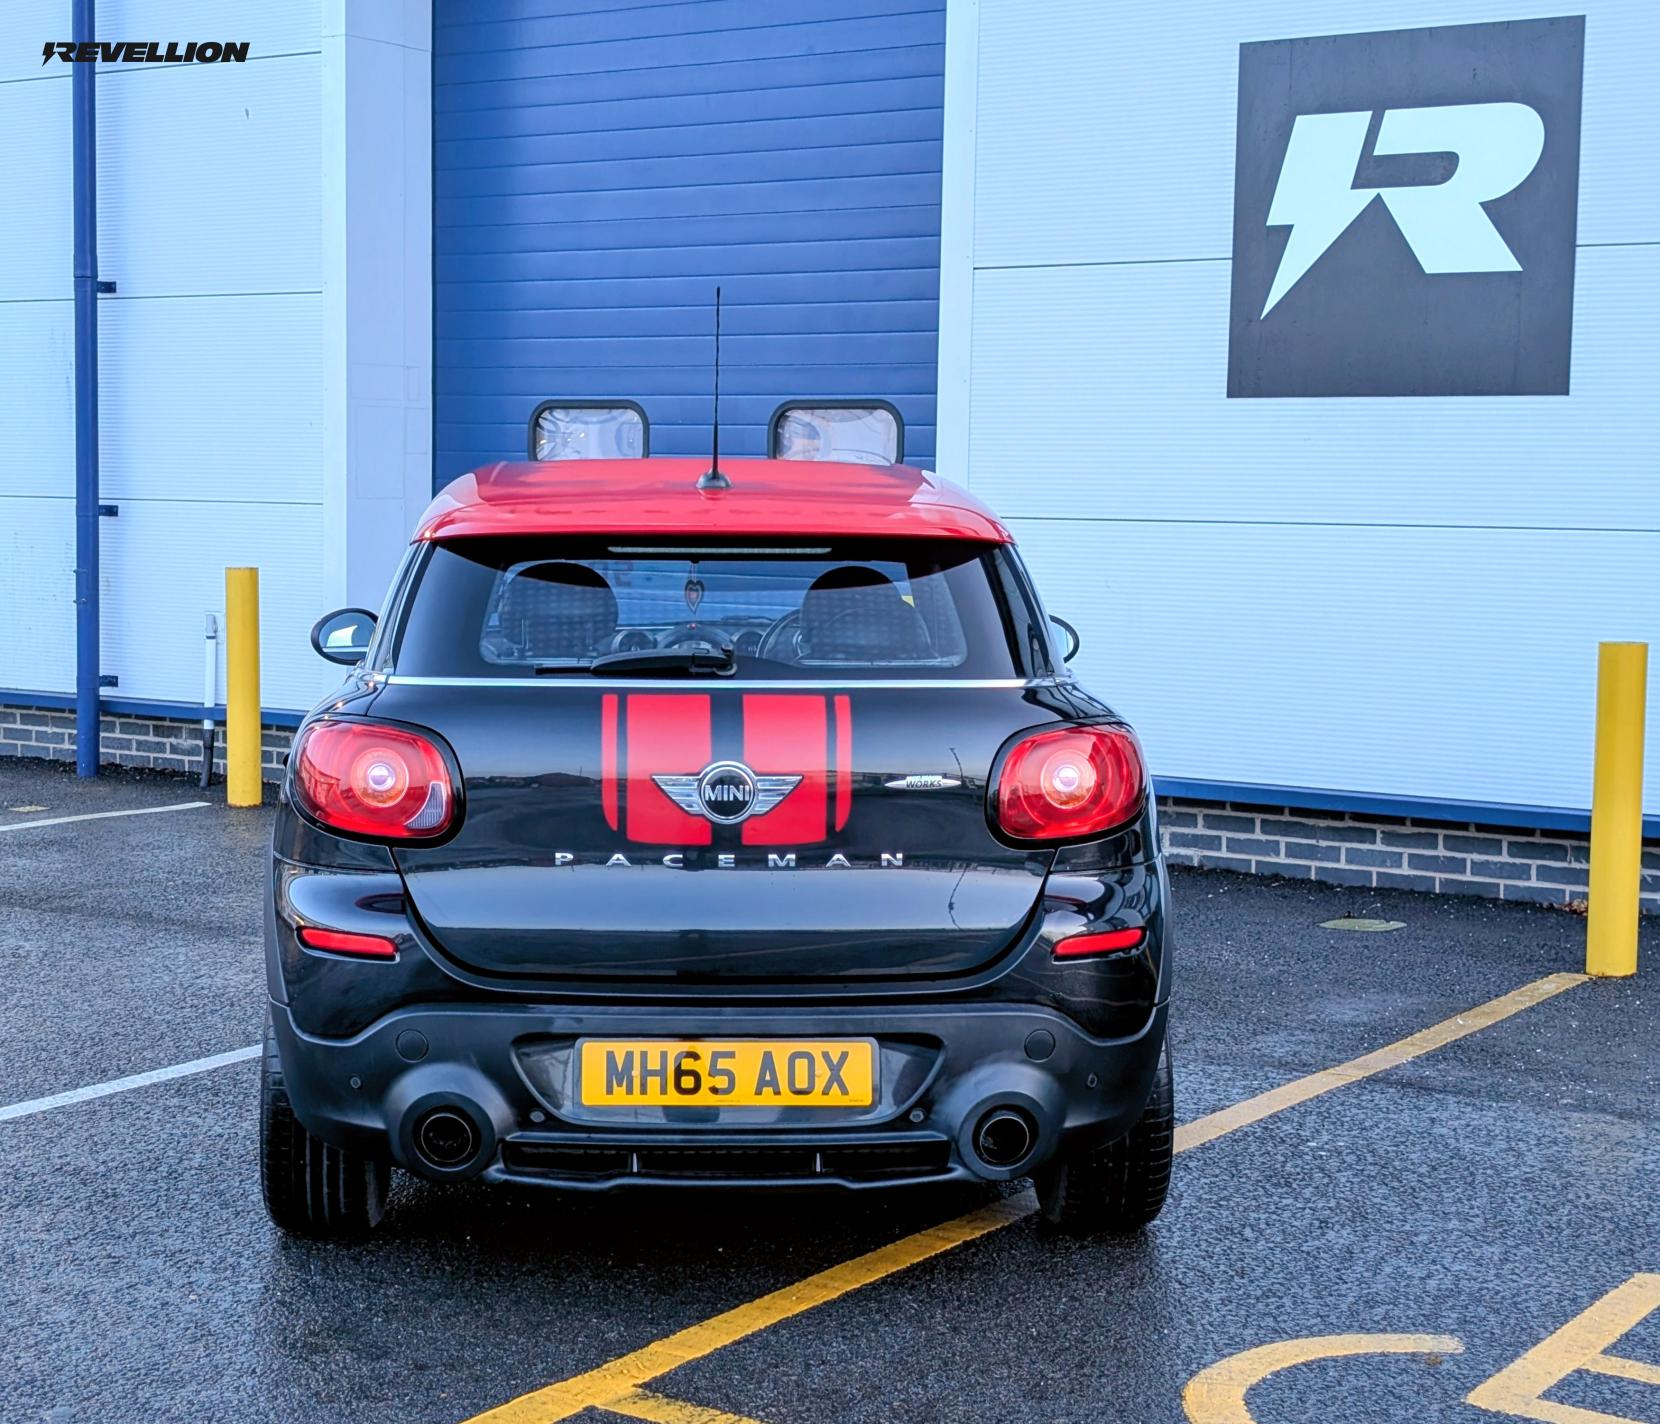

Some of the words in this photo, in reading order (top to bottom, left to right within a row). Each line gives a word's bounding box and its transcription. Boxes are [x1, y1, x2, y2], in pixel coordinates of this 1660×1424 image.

[1260, 102, 1545, 320] R
[705, 784, 750, 802] MINI
[906, 779, 942, 789] WORKS
[554, 852, 904, 868] PACEMAN
[605, 1050, 736, 1096] MH65
[754, 1050, 850, 1096] AOX
